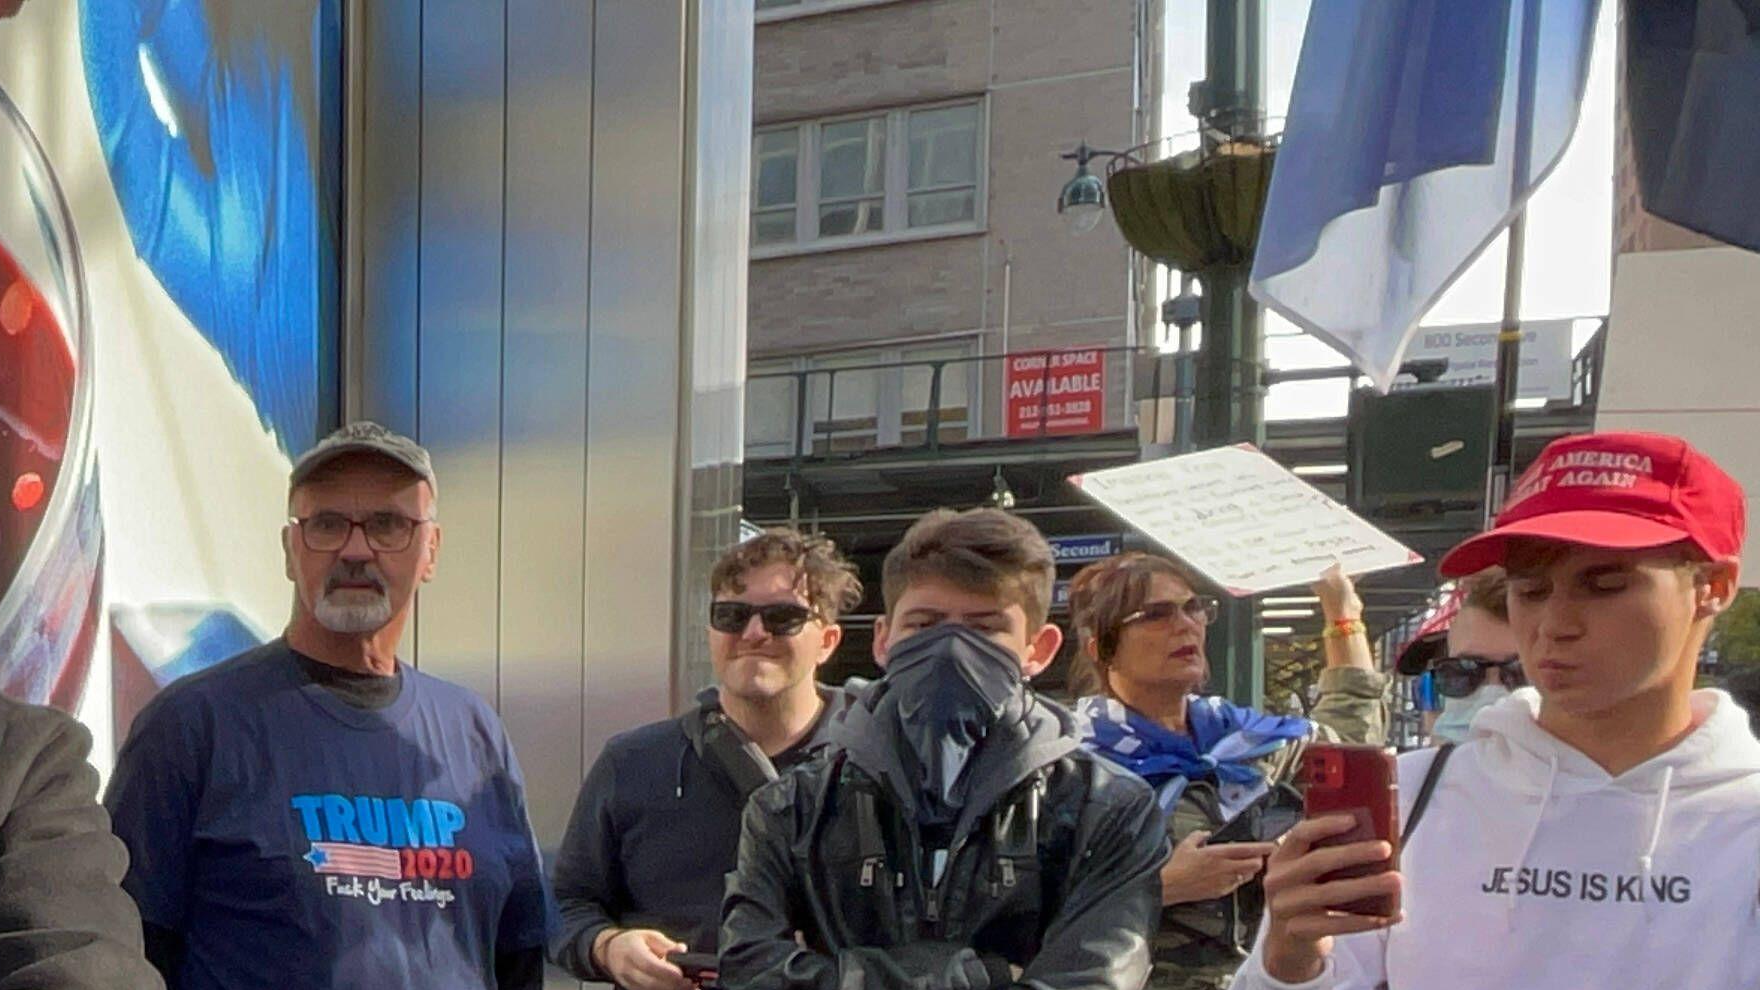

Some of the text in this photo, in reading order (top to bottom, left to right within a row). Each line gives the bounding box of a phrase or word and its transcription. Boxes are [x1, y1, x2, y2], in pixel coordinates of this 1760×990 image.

[1455, 331, 1498, 348] Secon
[1013, 351, 1098, 371] CORNR SPACE
[1548, 451, 1653, 472] AMERICA
[1557, 470, 1637, 489] AGAIN
[1050, 541, 1111, 558] Second
[291, 795, 466, 848] TRUMP
[402, 848, 473, 879] 2020
[326, 876, 455, 908] Fuck Your Feelings
[1482, 867, 1572, 898] JESUS
[1580, 872, 1608, 901] IS
